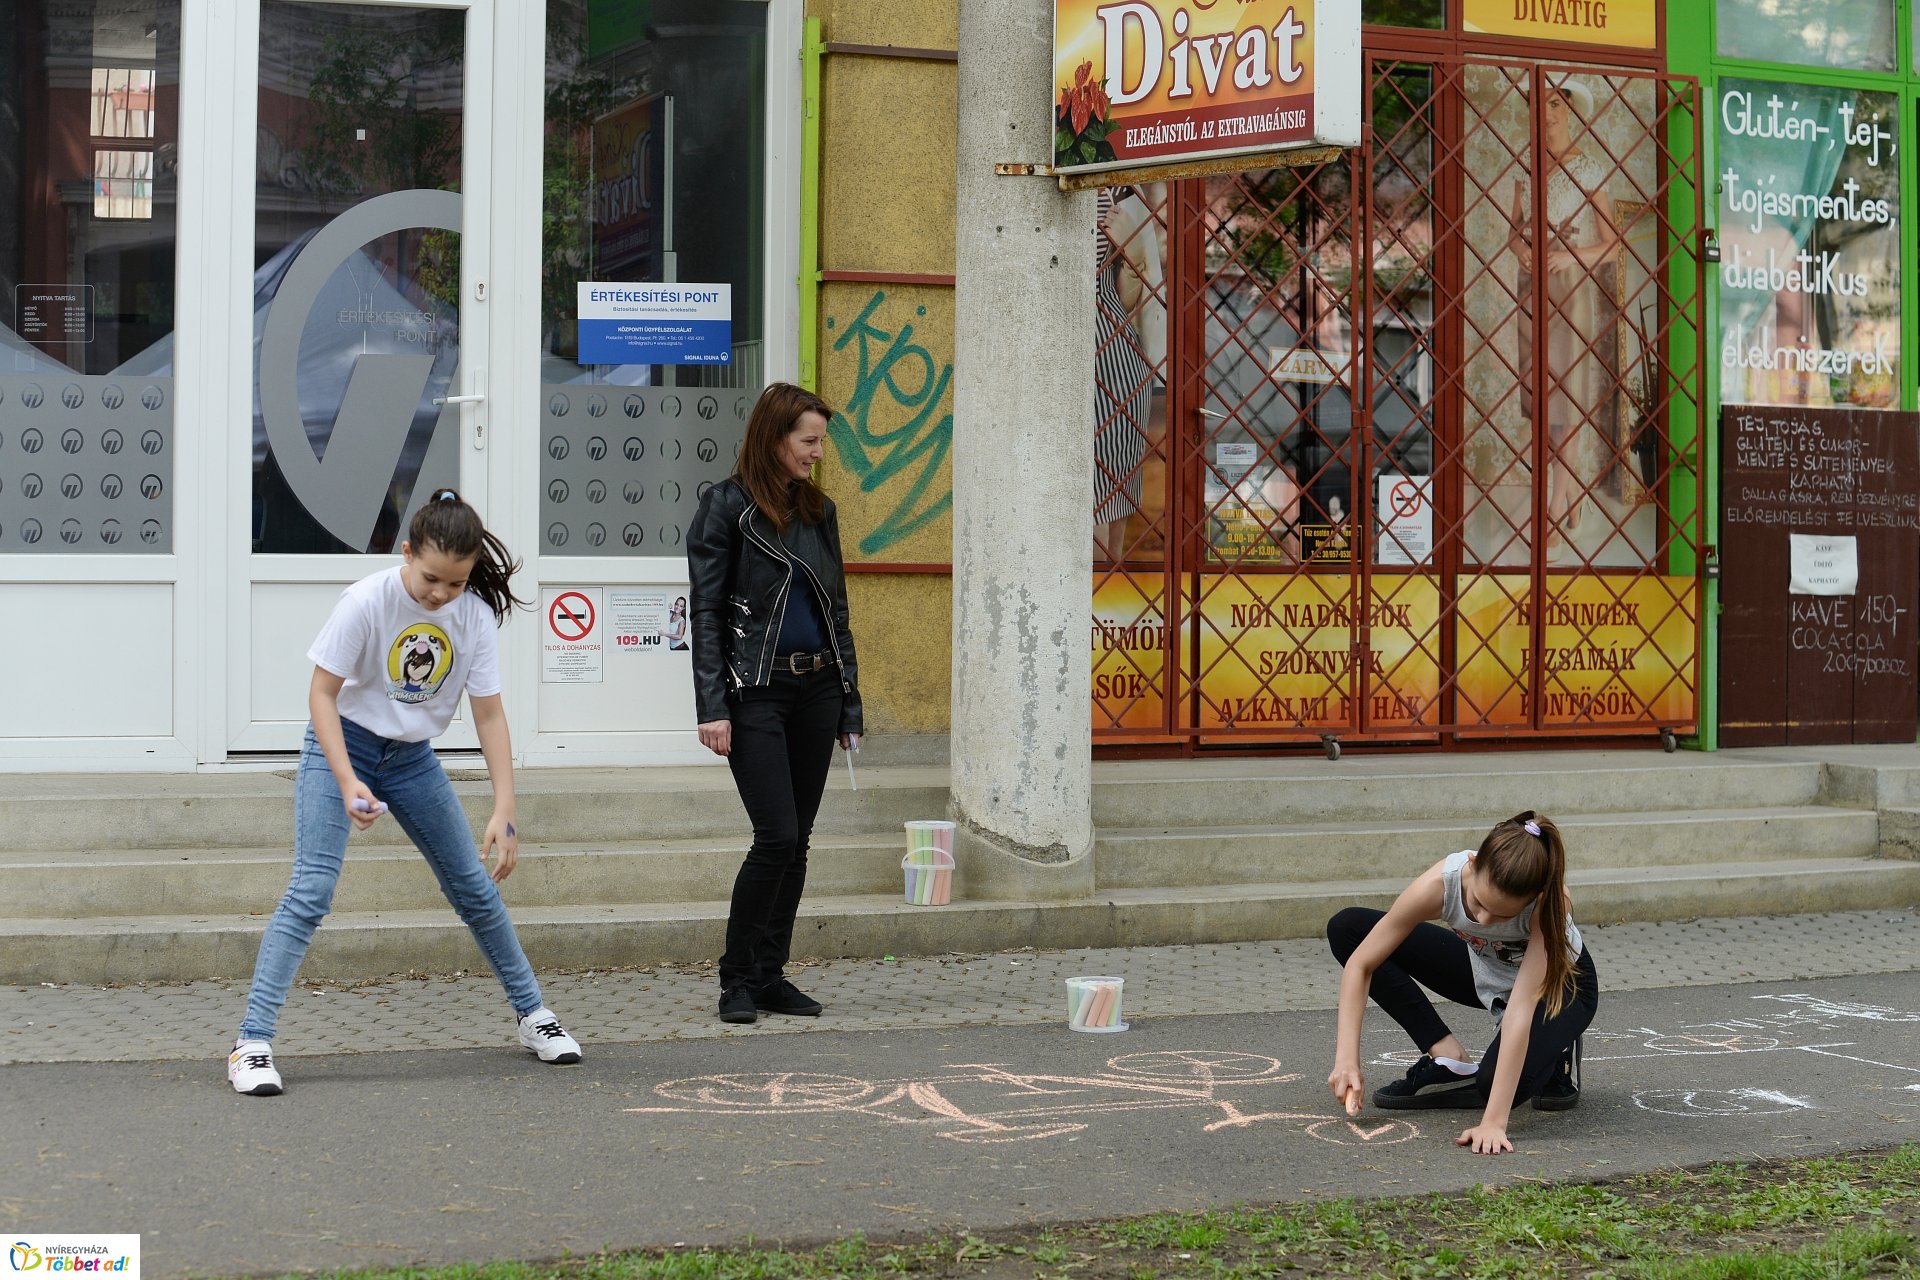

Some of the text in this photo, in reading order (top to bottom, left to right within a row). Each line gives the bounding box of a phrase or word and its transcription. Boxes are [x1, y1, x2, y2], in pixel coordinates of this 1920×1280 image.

[1514, 0, 1607, 28] DIVATIG
[1097, 0, 1305, 106] Divat
[1125, 107, 1307, 149] ELEGÁNSTÓL AZ EXTRAVAGÁNSIG
[1722, 167, 1896, 234] tojásmentes,
[591, 289, 719, 303] ÉRTÉKESÍTÉSI PONT
[397, 330, 437, 342] PONT
[1279, 353, 1340, 376] ZÁRVA
[1231, 595, 1272, 628] NŐI
[1517, 595, 1640, 627] HLÓINGEK
[616, 635, 661, 646] 109.HU
[1521, 640, 1636, 672] PZSAMÁK
[1259, 650, 1384, 675] SZOKNYK
[1092, 666, 1146, 699] SŐK
[1218, 688, 1422, 722] ALKALMI RHÁK
